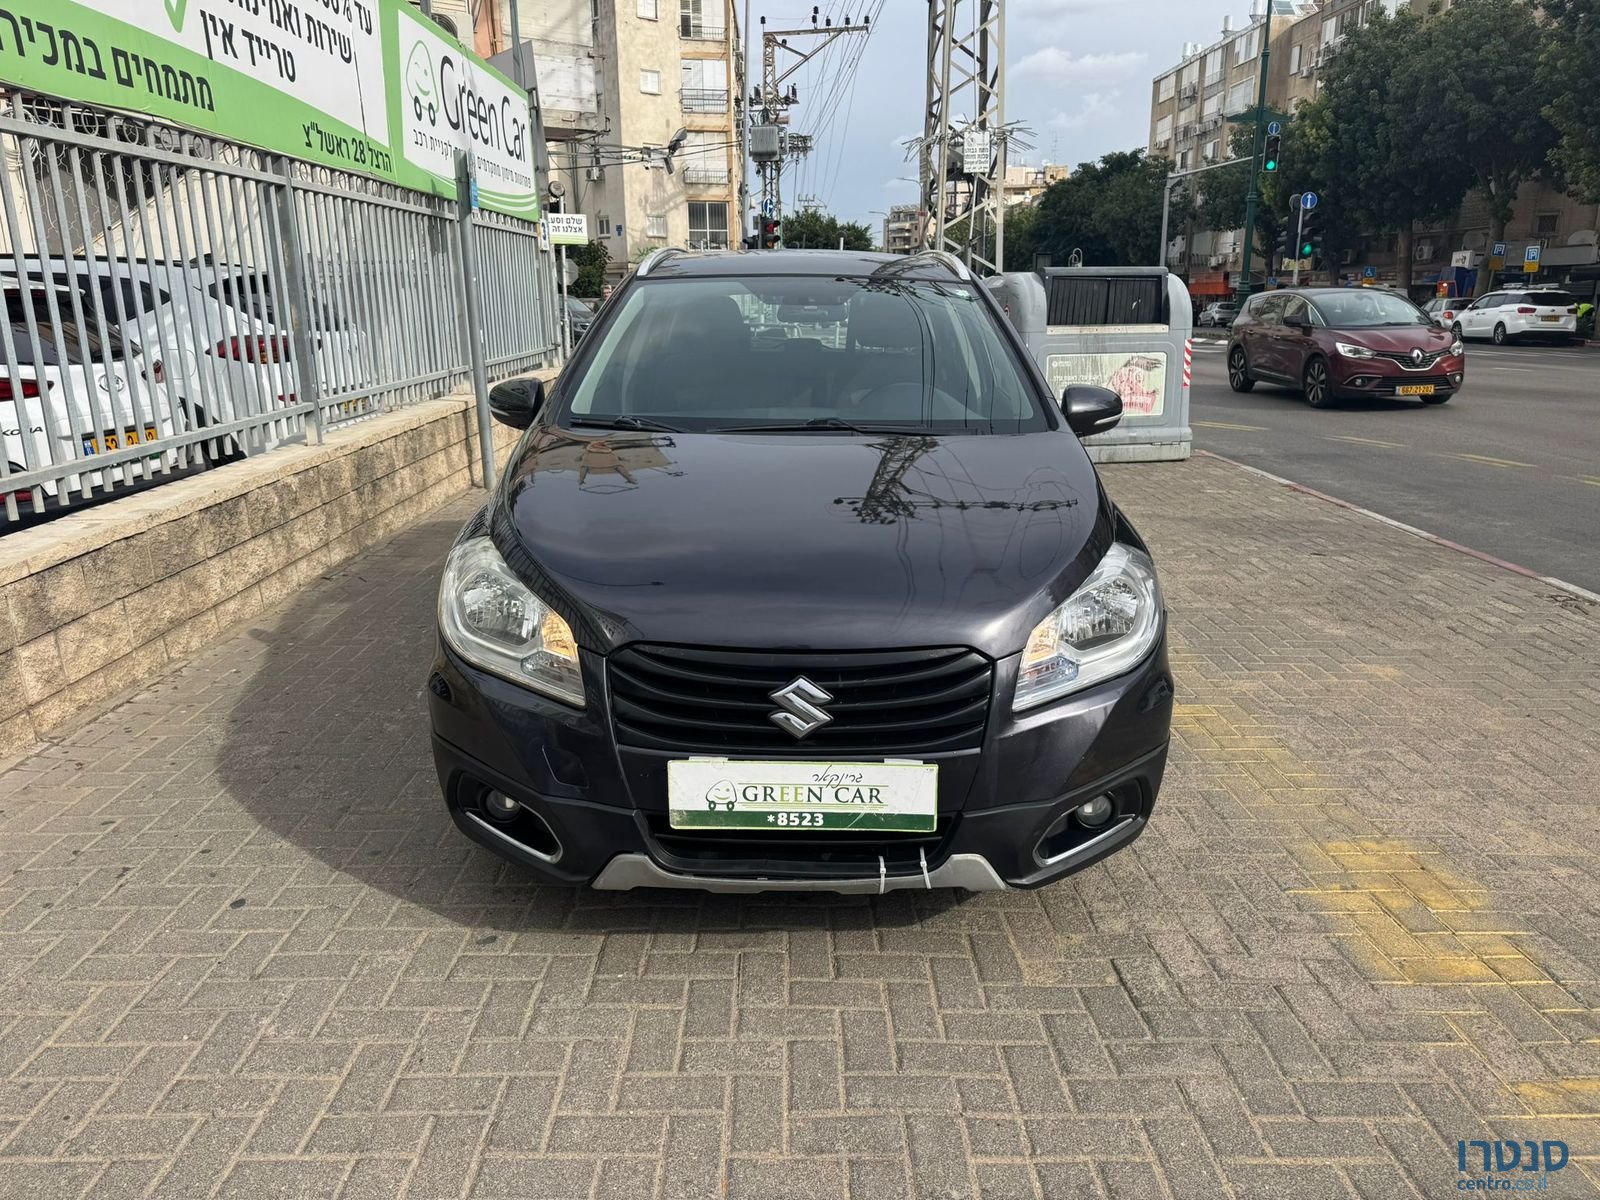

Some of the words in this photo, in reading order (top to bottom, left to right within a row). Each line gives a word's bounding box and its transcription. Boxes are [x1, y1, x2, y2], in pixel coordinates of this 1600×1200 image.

[199, 9, 239, 61] אין
[353, 0, 373, 36] עד
[0, 8, 107, 81] במכיר
[304, 12, 353, 64] שירות
[241, 28, 296, 83] טרייד
[110, 46, 216, 112] מתמחים
[440, 55, 501, 151] Green
[501, 95, 526, 163] Car
[351, 137, 367, 165] 28
[412, 128, 429, 150] רכב
[430, 136, 453, 161] לקניית
[366, 141, 392, 174] הרצל
[562, 225, 584, 233] אצלנו
[565, 216, 583, 225] שלם
[742, 785, 824, 803] GREEN
[834, 787, 884, 804] CAR
